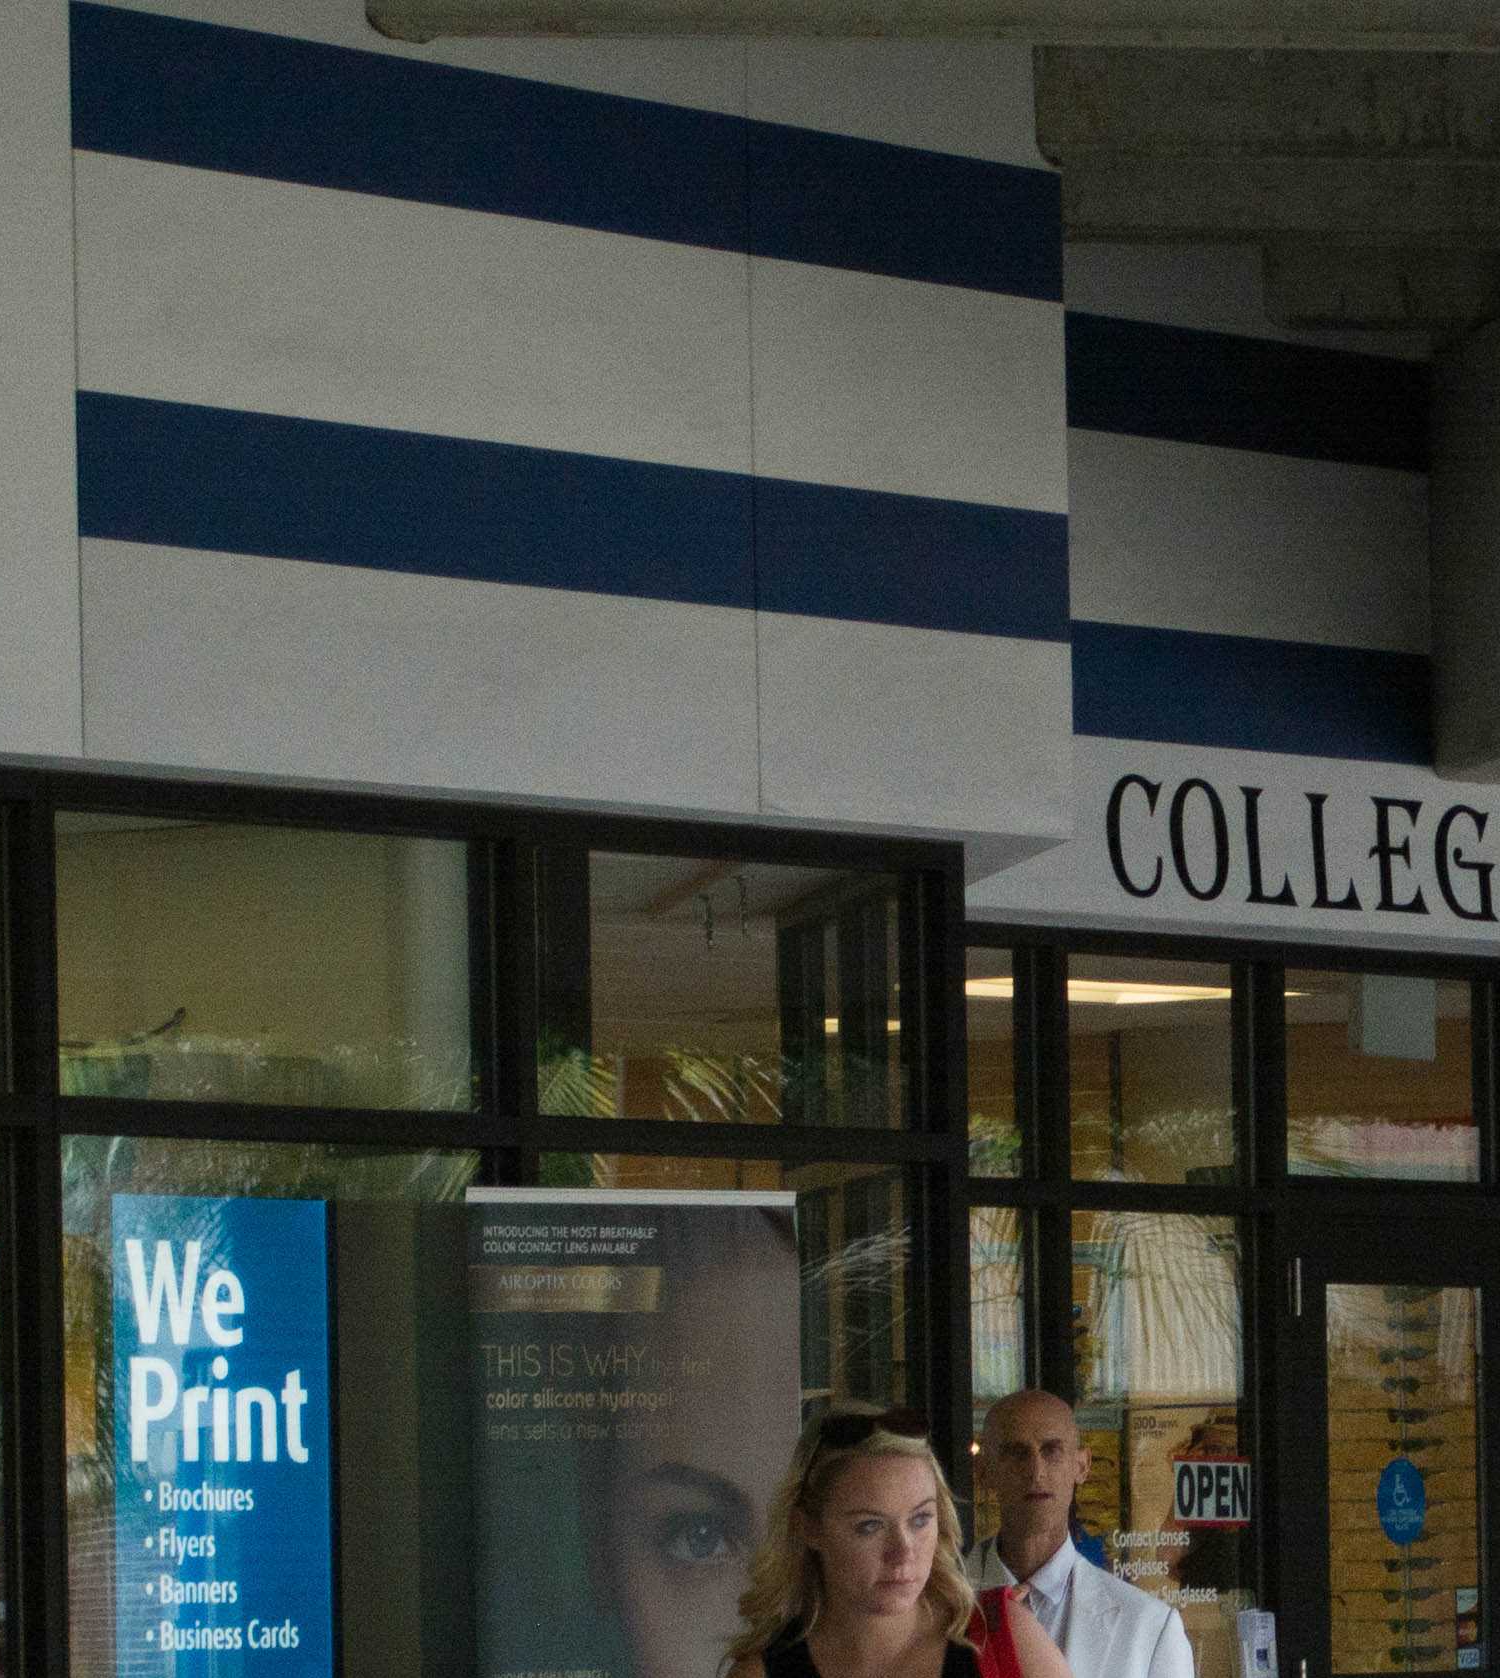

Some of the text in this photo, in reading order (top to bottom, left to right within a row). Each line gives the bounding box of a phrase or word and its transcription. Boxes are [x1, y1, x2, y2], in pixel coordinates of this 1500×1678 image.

[519, 1241, 563, 1254] CONTACT
[565, 1242, 589, 1255] LENS
[125, 1238, 245, 1348] We
[481, 1343, 542, 1377] THIS
[549, 1343, 575, 1376] IS
[581, 1344, 648, 1376] WHY
[128, 1355, 310, 1464] Print
[485, 1388, 529, 1409] color
[532, 1387, 596, 1409] silicone
[158, 1480, 255, 1512] Brochures
[1176, 1464, 1248, 1518] OPEN
[159, 1526, 216, 1564] Flyers
[1112, 1529, 1191, 1548] Contact Lenses
[1112, 1558, 1170, 1582] Eyeglasses
[159, 1574, 238, 1604] Banners
[1160, 1584, 1219, 1608] Sunglasses
[160, 1618, 300, 1651] Business Cards
